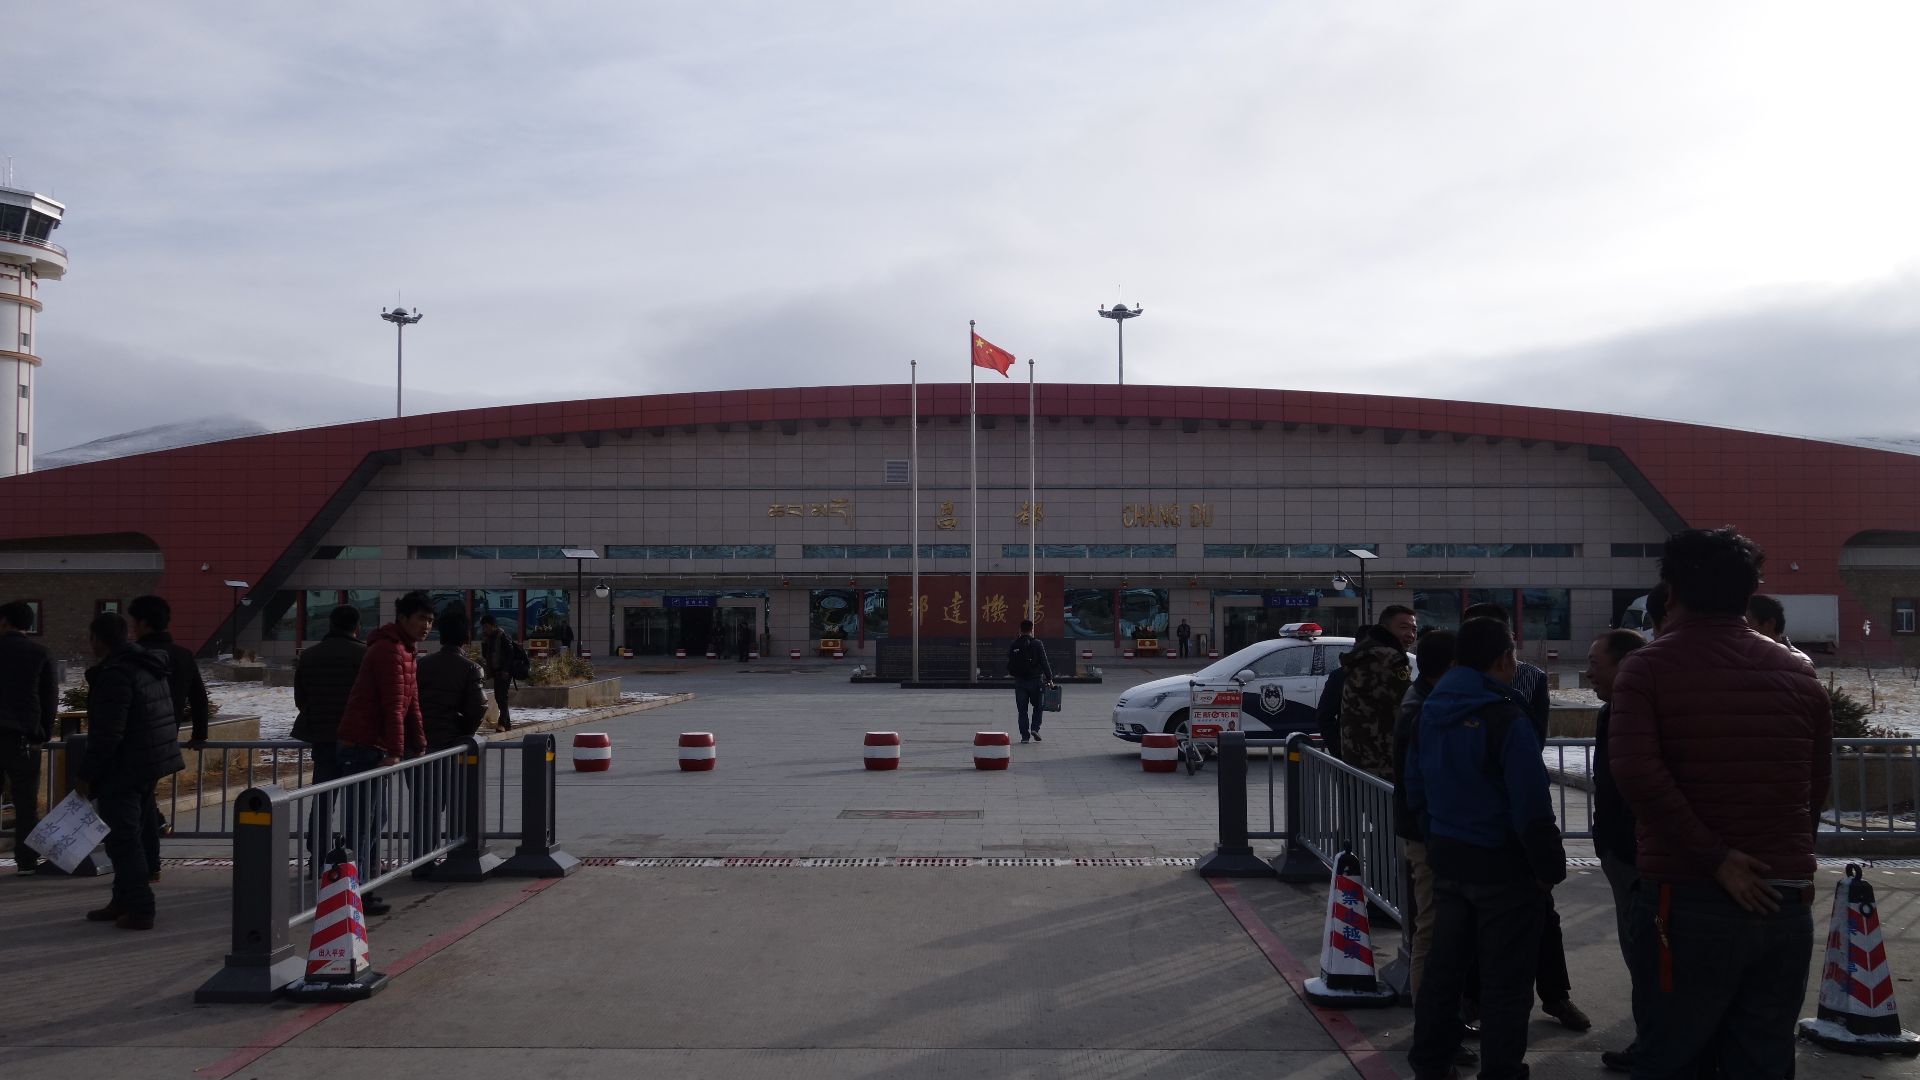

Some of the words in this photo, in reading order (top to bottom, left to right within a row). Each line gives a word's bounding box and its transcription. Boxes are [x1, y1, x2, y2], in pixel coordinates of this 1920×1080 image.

[1122, 503, 1181, 529] CHANG
[1190, 503, 1214, 528] DU
[318, 948, 346, 958] 出入平安
